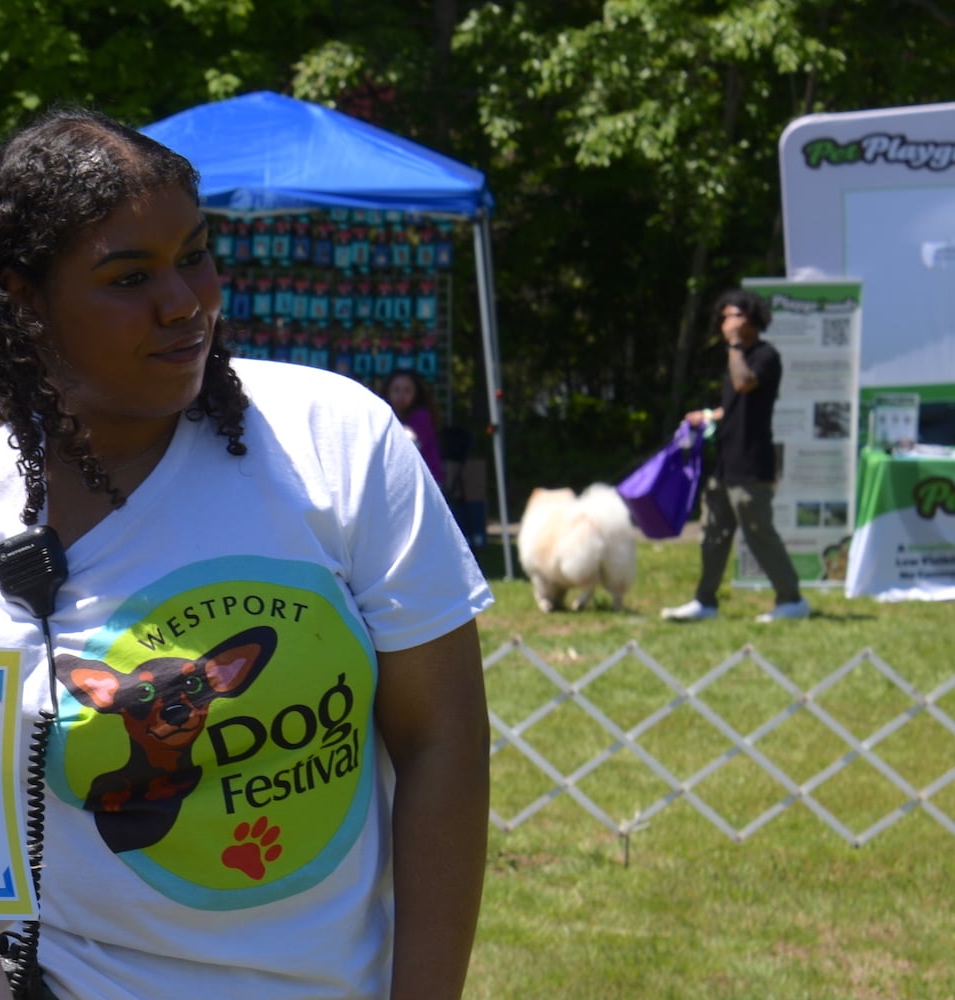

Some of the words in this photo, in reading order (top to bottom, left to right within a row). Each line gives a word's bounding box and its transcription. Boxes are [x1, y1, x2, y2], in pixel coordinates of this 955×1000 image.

[803, 138, 860, 167] Pet
[861, 132, 955, 170] Playg
[138, 595, 308, 652] WESTPORT
[207, 672, 354, 767] Dog
[221, 728, 360, 815] Festival
